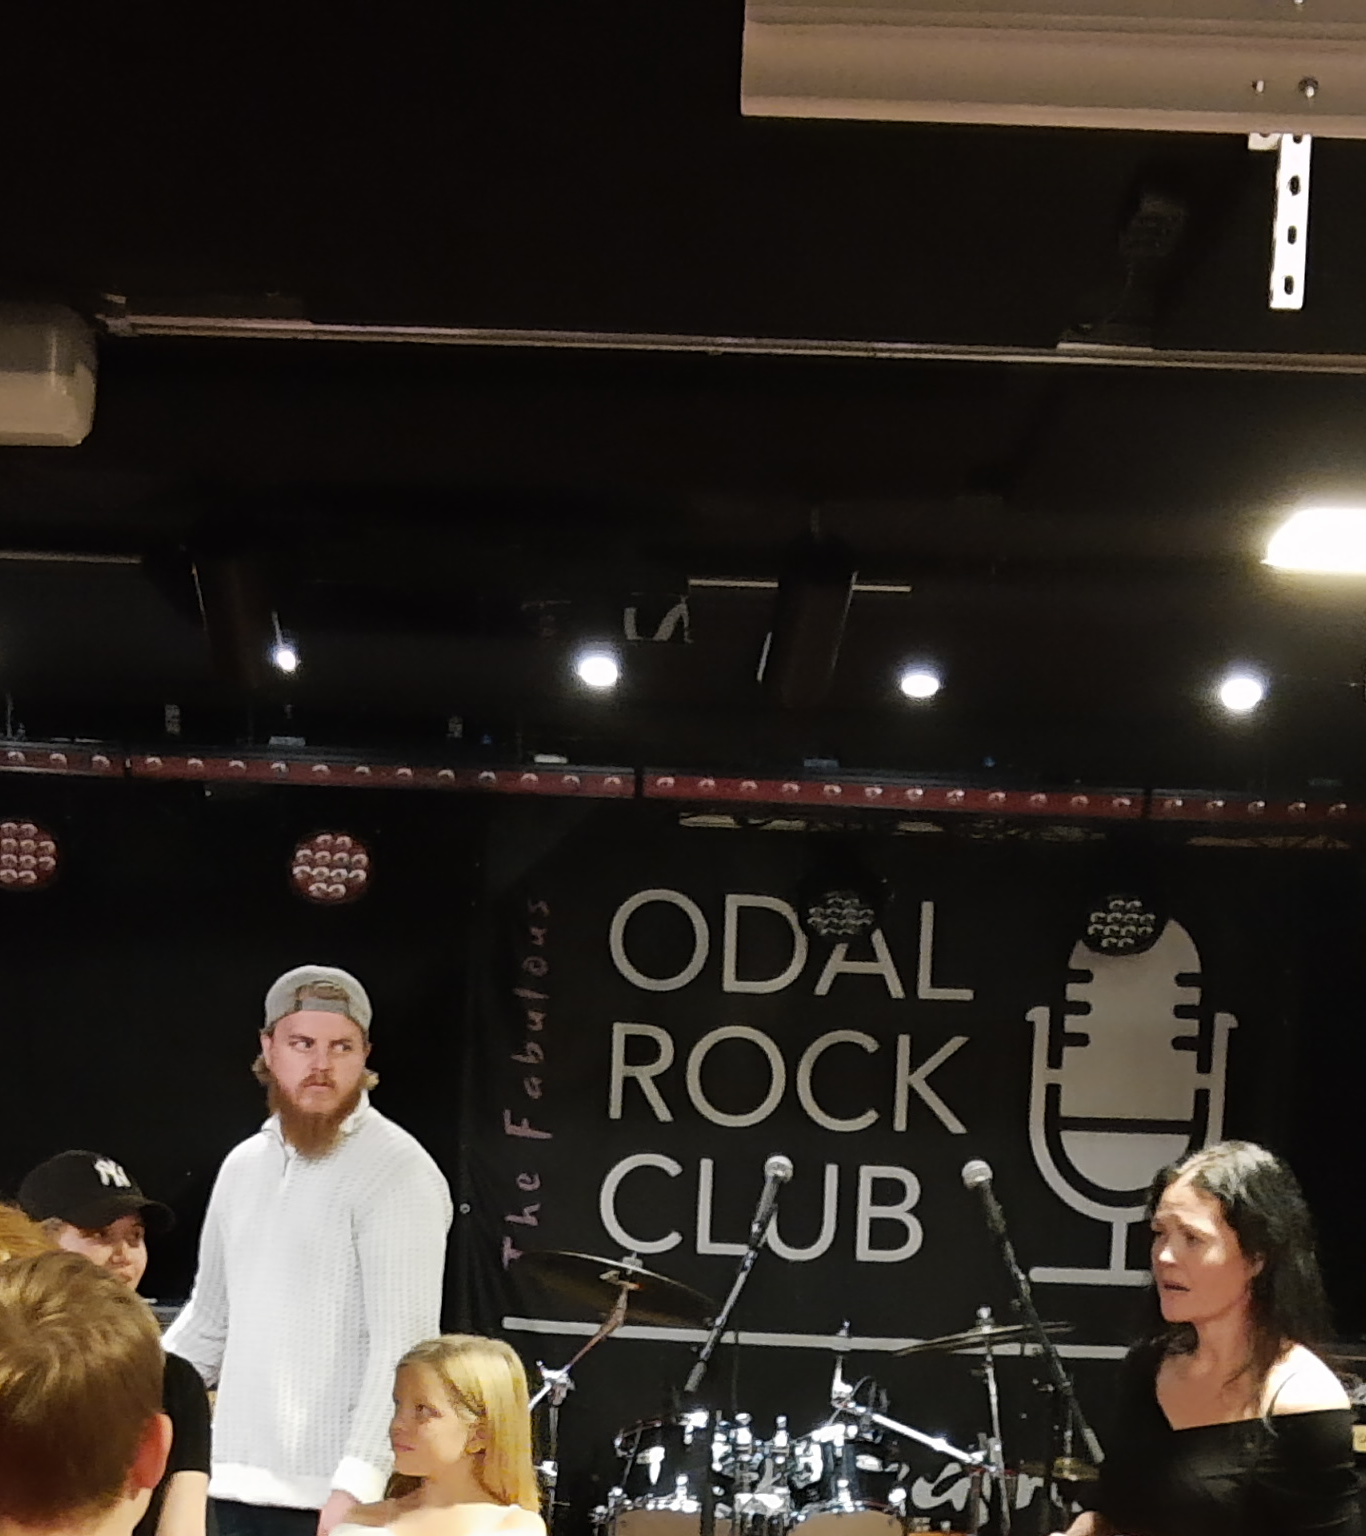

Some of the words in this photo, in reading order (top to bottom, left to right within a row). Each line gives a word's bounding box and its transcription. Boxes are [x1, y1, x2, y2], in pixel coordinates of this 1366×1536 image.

[609, 888, 975, 1001] ODAL
[503, 899, 552, 1140] Fabulous
[608, 1022, 970, 1135] ROCK
[502, 1170, 542, 1269] The
[599, 1153, 924, 1262] CLUB
